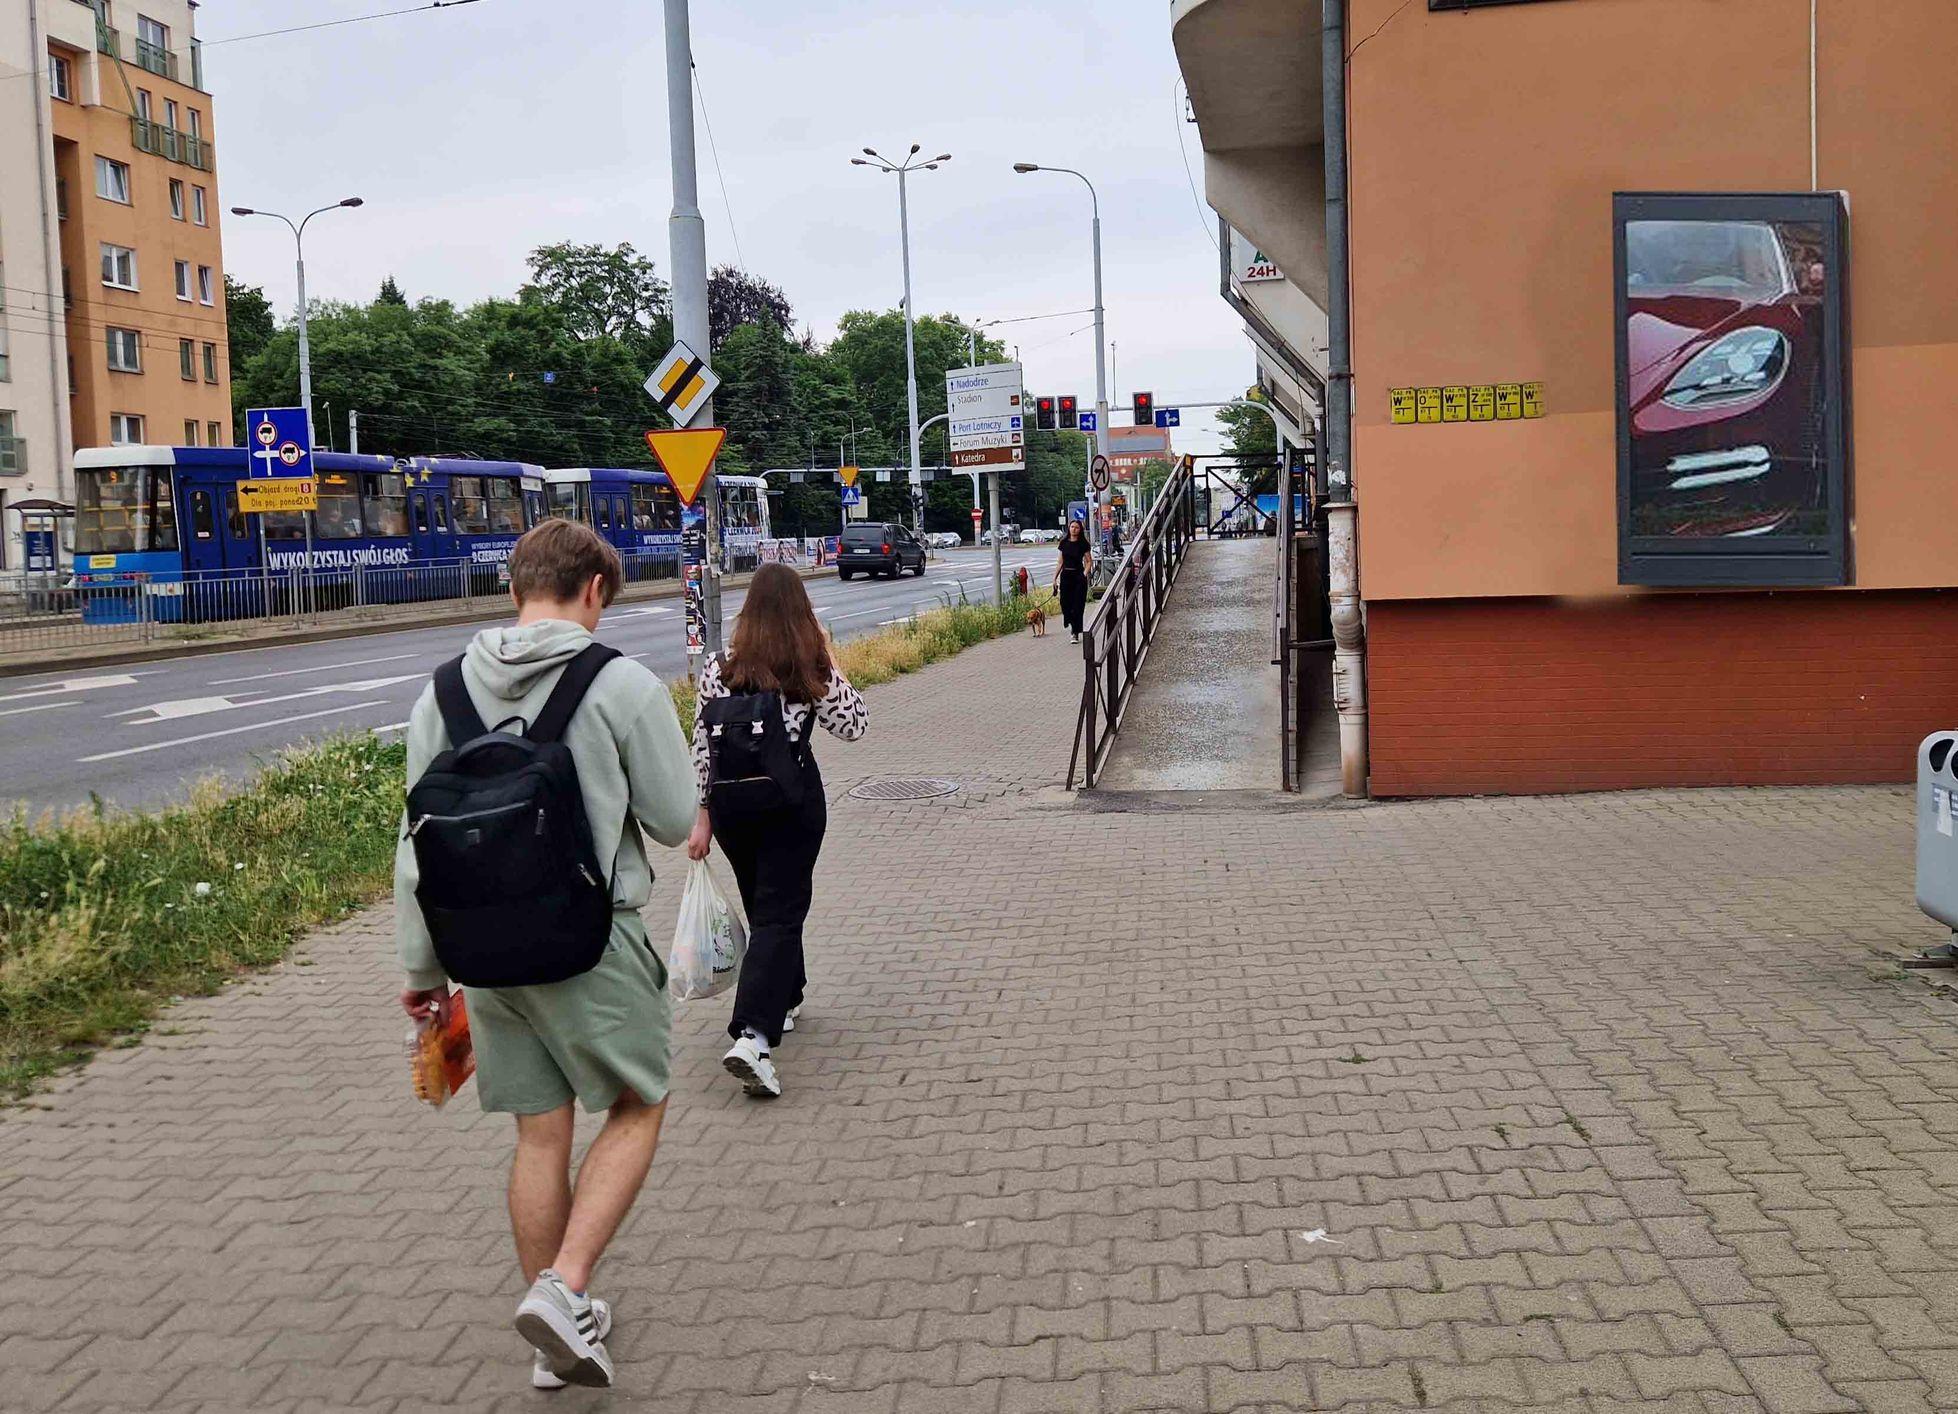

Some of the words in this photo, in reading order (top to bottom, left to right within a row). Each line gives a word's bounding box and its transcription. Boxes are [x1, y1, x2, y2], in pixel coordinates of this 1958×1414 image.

[1247, 266, 1276, 278] 24H
[956, 377, 989, 389] Nadodrze
[957, 394, 982, 404] Stadion
[1419, 395, 1427, 405] O
[1444, 394, 1454, 404] W
[1471, 393, 1479, 403] Z
[1498, 391, 1508, 401] W
[1524, 390, 1534, 400] W
[1393, 396, 1403, 406] W
[958, 423, 971, 433] Port
[973, 421, 1002, 431] Lotniczy
[960, 438, 980, 447] Forum
[981, 434, 1007, 446] Muzyki
[961, 453, 986, 463] Katedra
[258, 484, 281, 494] Objazd
[283, 485, 300, 494] drogi
[251, 498, 262, 507] Dla
[299, 496, 310, 505] 20
[353, 544, 382, 566] SWÓJ
